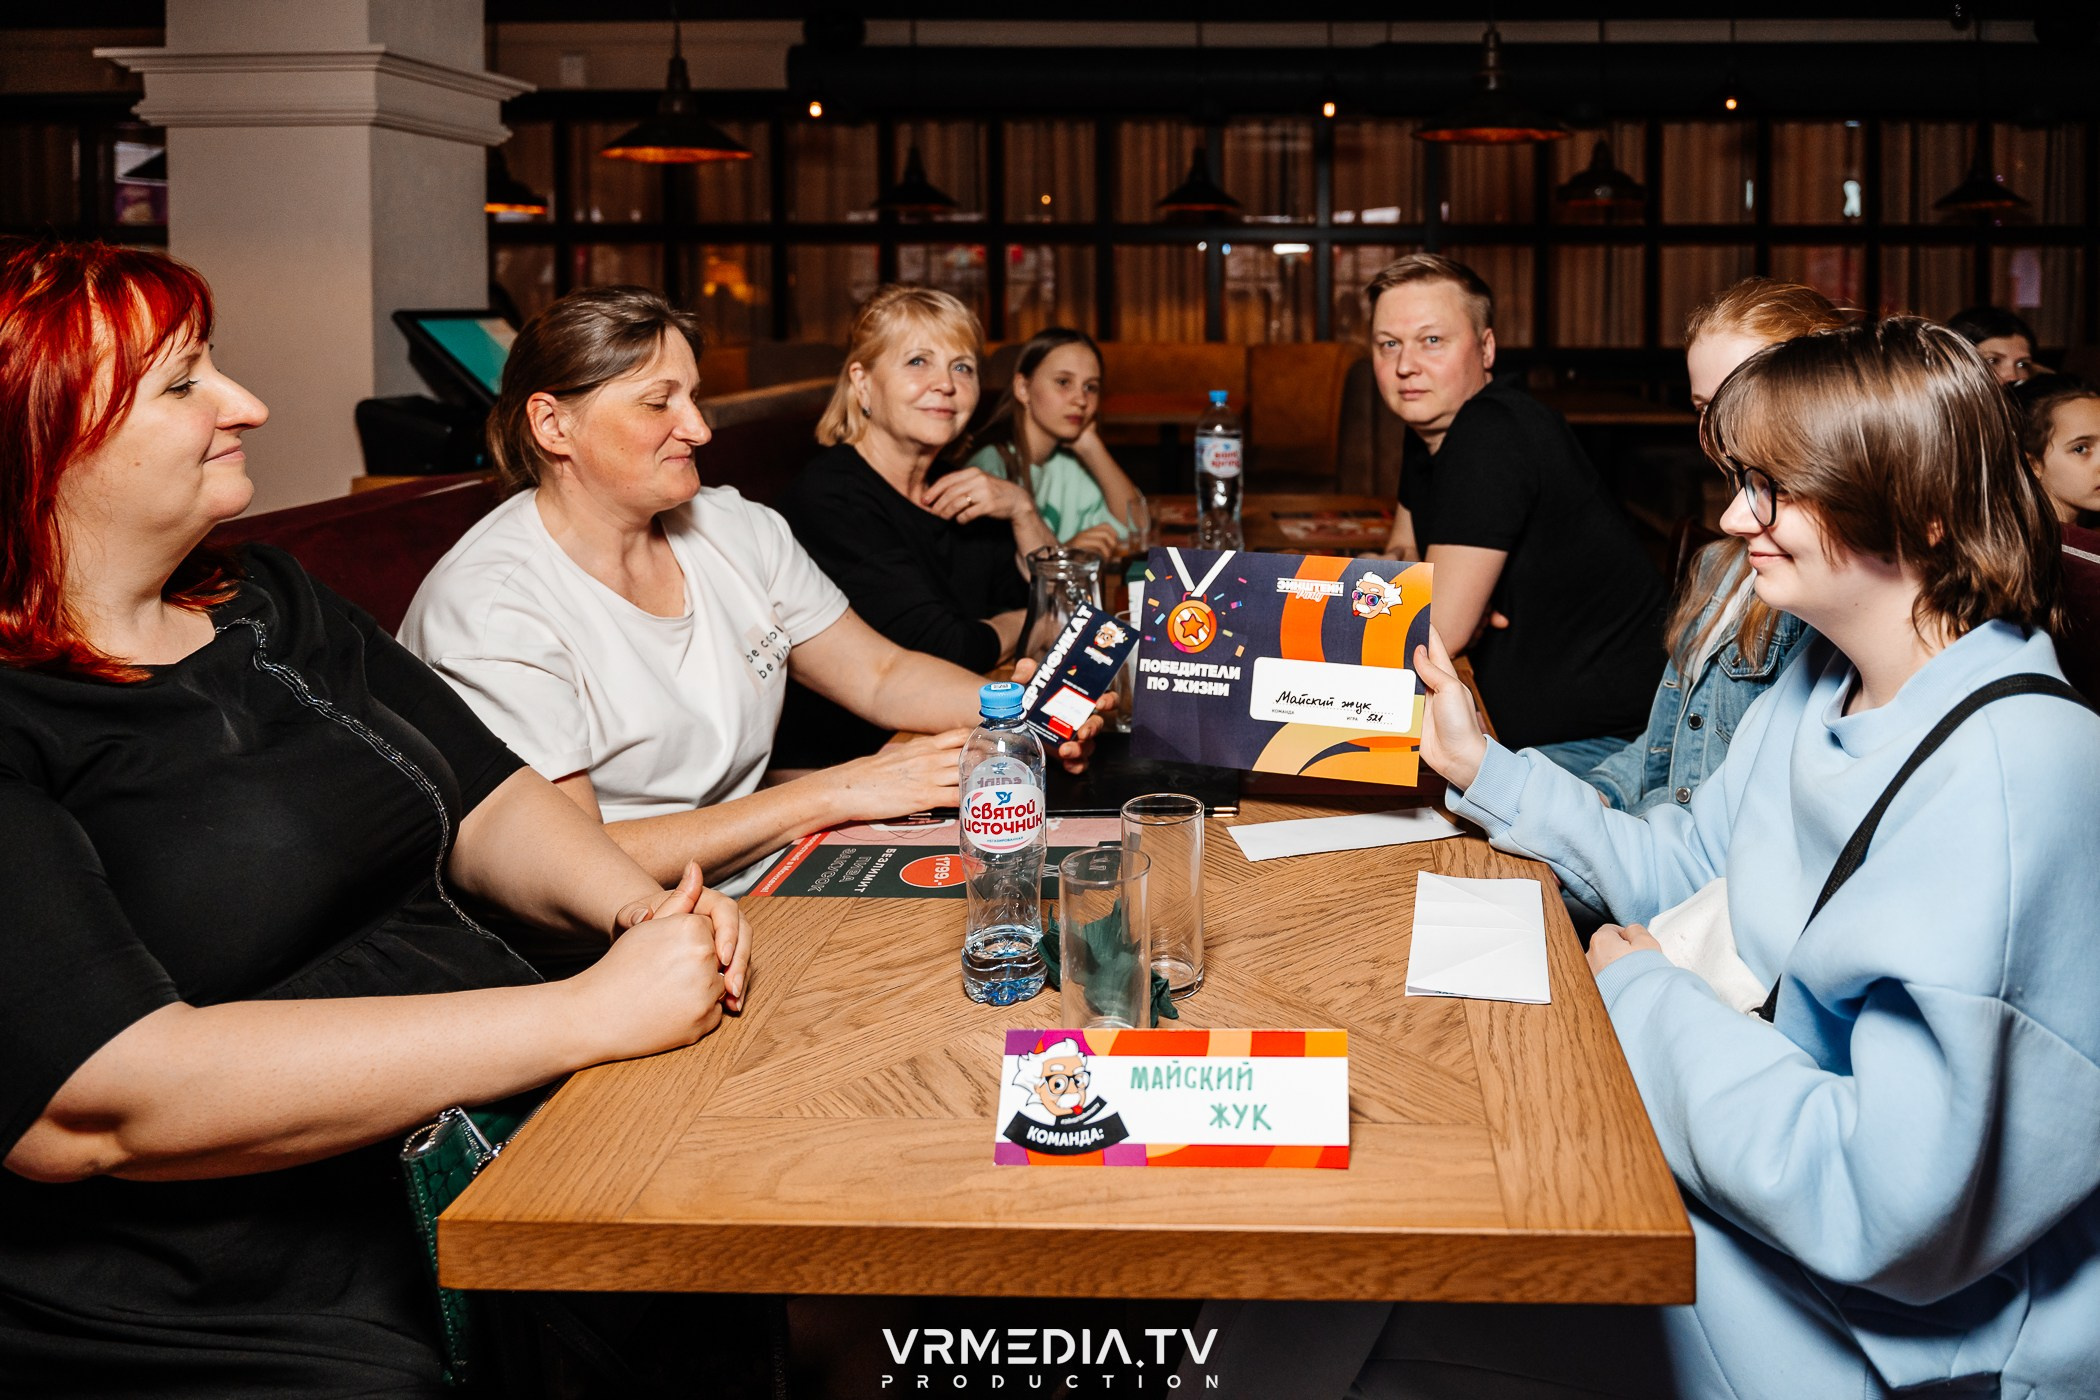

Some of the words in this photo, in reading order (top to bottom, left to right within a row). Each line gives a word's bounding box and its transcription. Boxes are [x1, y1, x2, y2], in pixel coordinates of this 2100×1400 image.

[757, 663, 774, 679] be
[1139, 658, 1241, 680] ПОБЕДИТЕЛИ
[1146, 676, 1169, 691] ПО
[1172, 678, 1230, 697] ЖИЗНИ
[1275, 690, 1335, 707] Майский
[1341, 700, 1372, 714] жук
[1366, 713, 1383, 722] 521
[807, 848, 857, 892] ЗАКУСОК
[838, 856, 872, 883] ПИВА
[854, 848, 897, 893] БЕЗЛИМИТ
[1130, 1060, 1253, 1092] МАЙСКИЙ
[1209, 1103, 1272, 1131] ЖУК
[1026, 1125, 1105, 1147] КОМАНДА:
